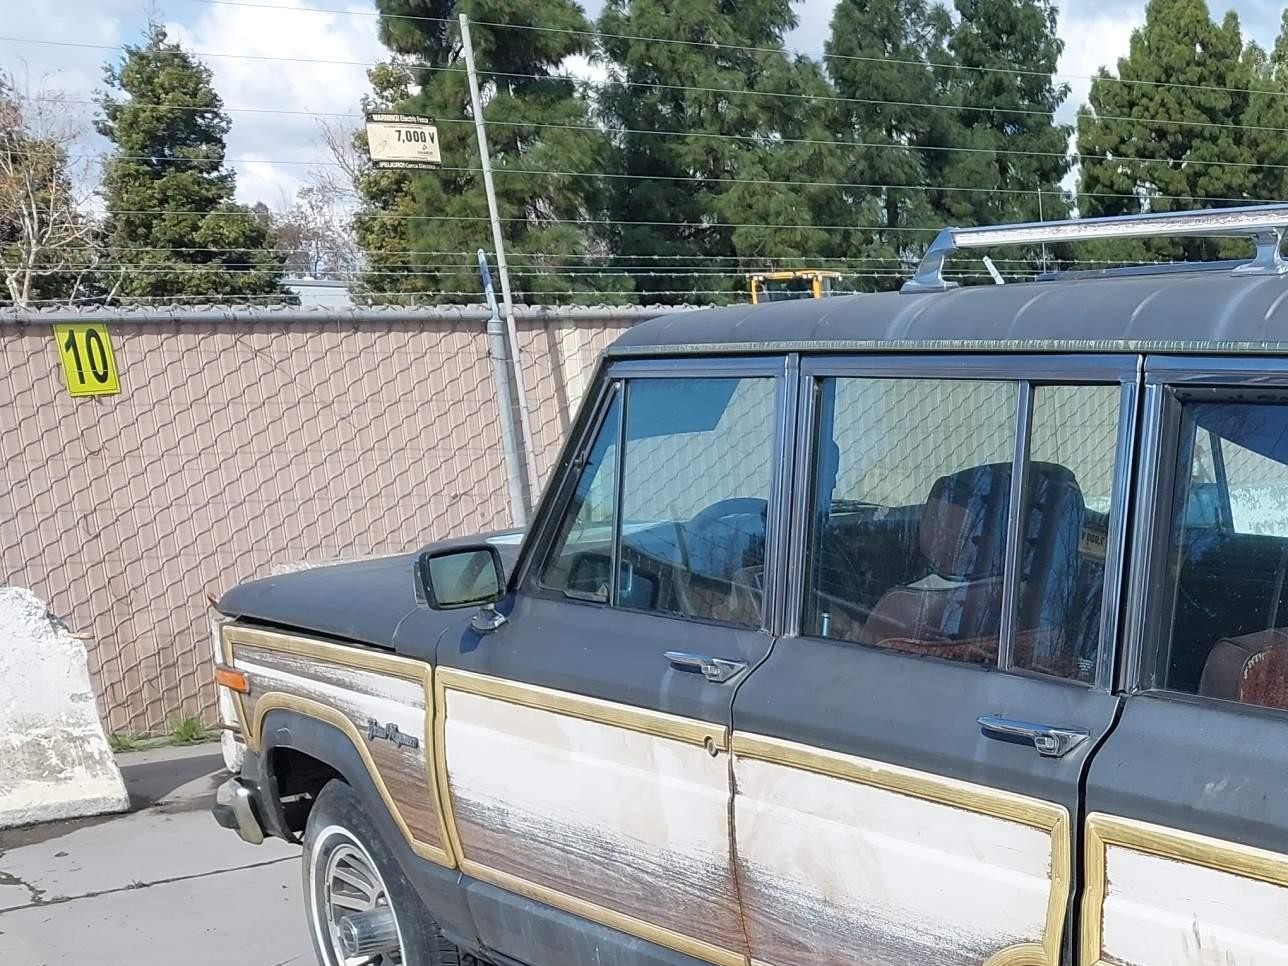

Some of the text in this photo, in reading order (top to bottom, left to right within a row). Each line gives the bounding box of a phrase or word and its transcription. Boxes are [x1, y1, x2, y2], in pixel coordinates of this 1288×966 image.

[395, 129, 435, 144] 7,000 V
[64, 328, 109, 384] 10
